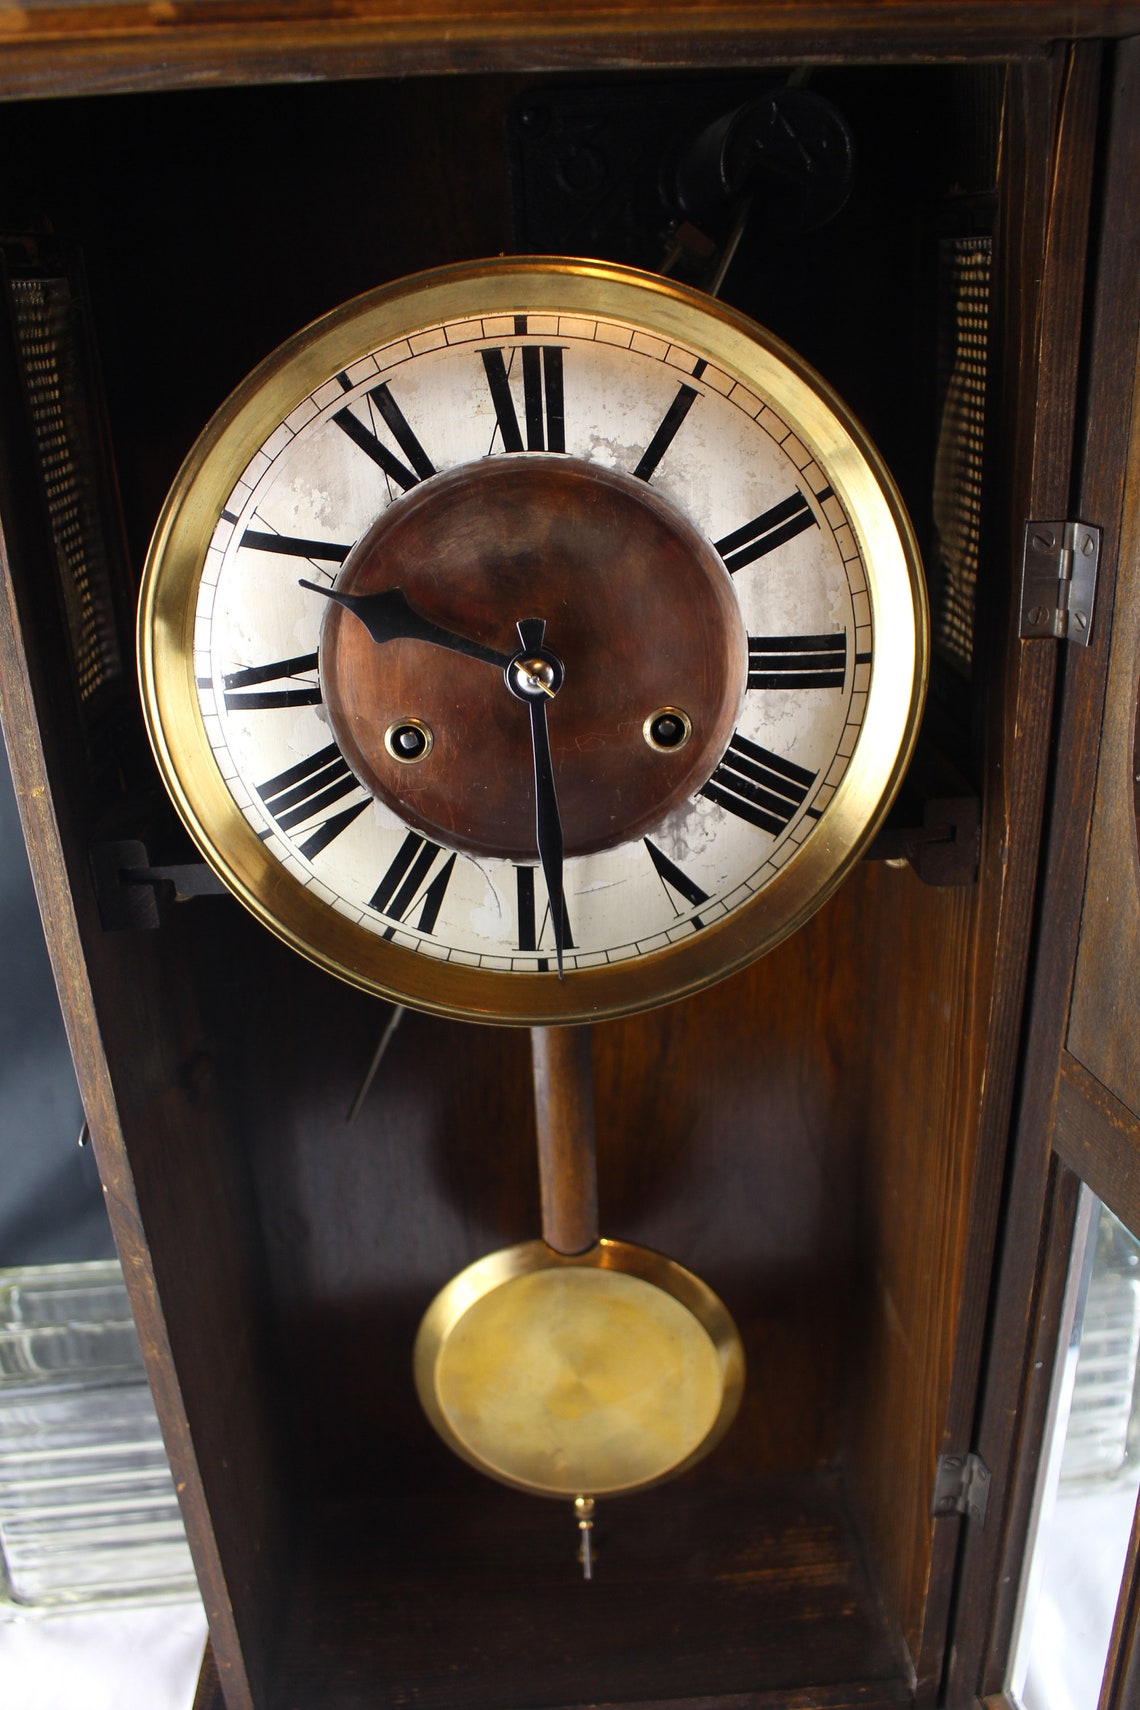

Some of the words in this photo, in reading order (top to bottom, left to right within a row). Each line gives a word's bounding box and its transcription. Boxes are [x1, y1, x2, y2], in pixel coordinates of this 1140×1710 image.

[327, 379, 443, 507] XI
[475, 345, 570, 458] XII
[628, 380, 705, 486] I
[237, 507, 357, 587] X
[709, 485, 821, 580] II
[223, 646, 323, 715] IX
[745, 626, 846, 694] III
[253, 742, 374, 865] VIII
[694, 728, 820, 842] IIII
[362, 827, 456, 936] VII
[643, 837, 716, 919] V
